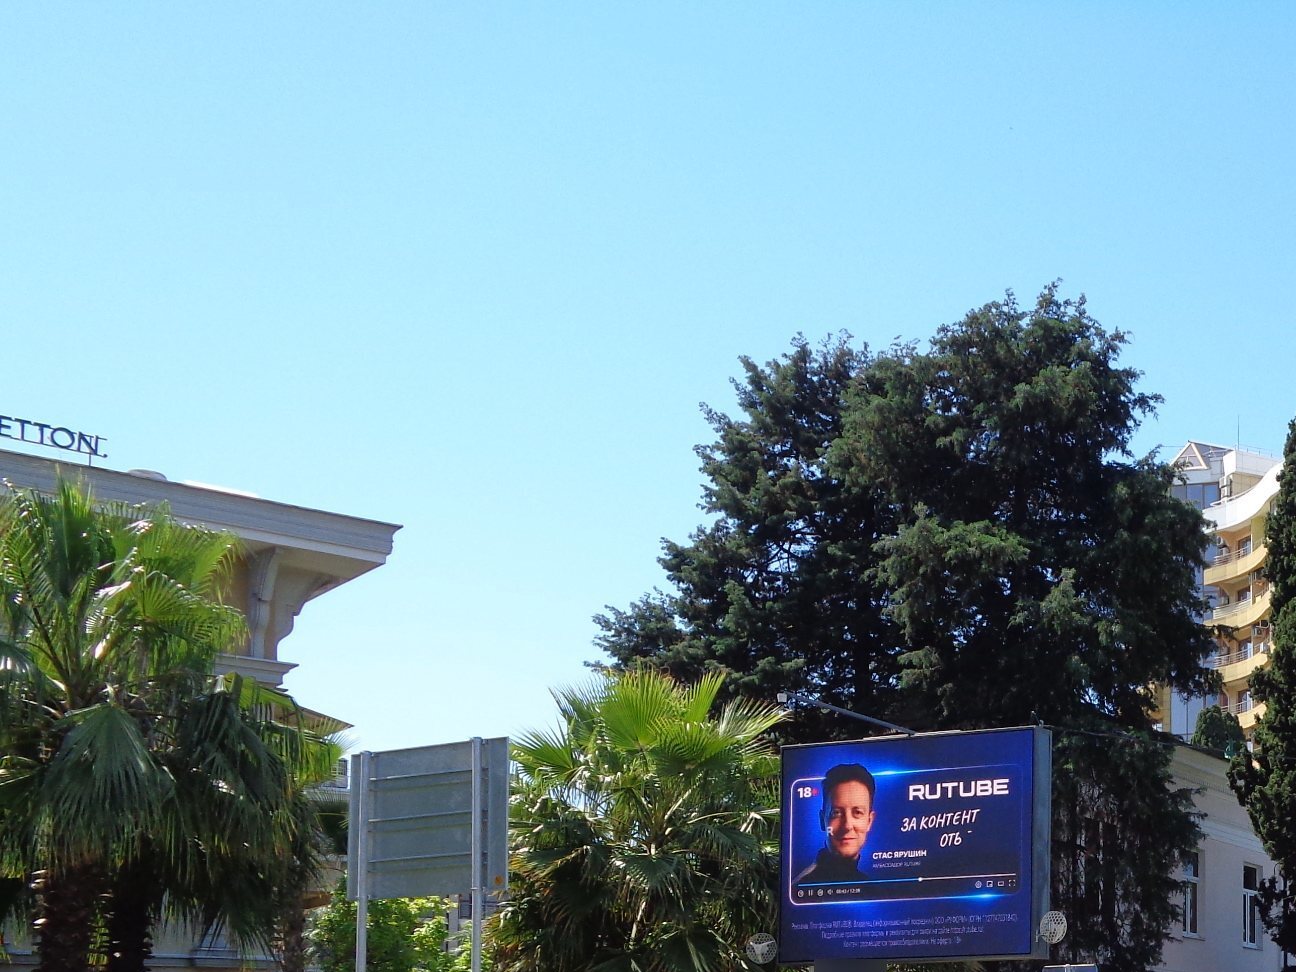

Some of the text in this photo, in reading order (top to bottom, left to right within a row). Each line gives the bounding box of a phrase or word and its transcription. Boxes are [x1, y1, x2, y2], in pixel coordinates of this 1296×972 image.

[909, 778, 1010, 801] RUTUBE
[900, 808, 981, 832] ЗА КОНТЕНТ
[872, 849, 927, 860] СТАС ЯРУШИН
